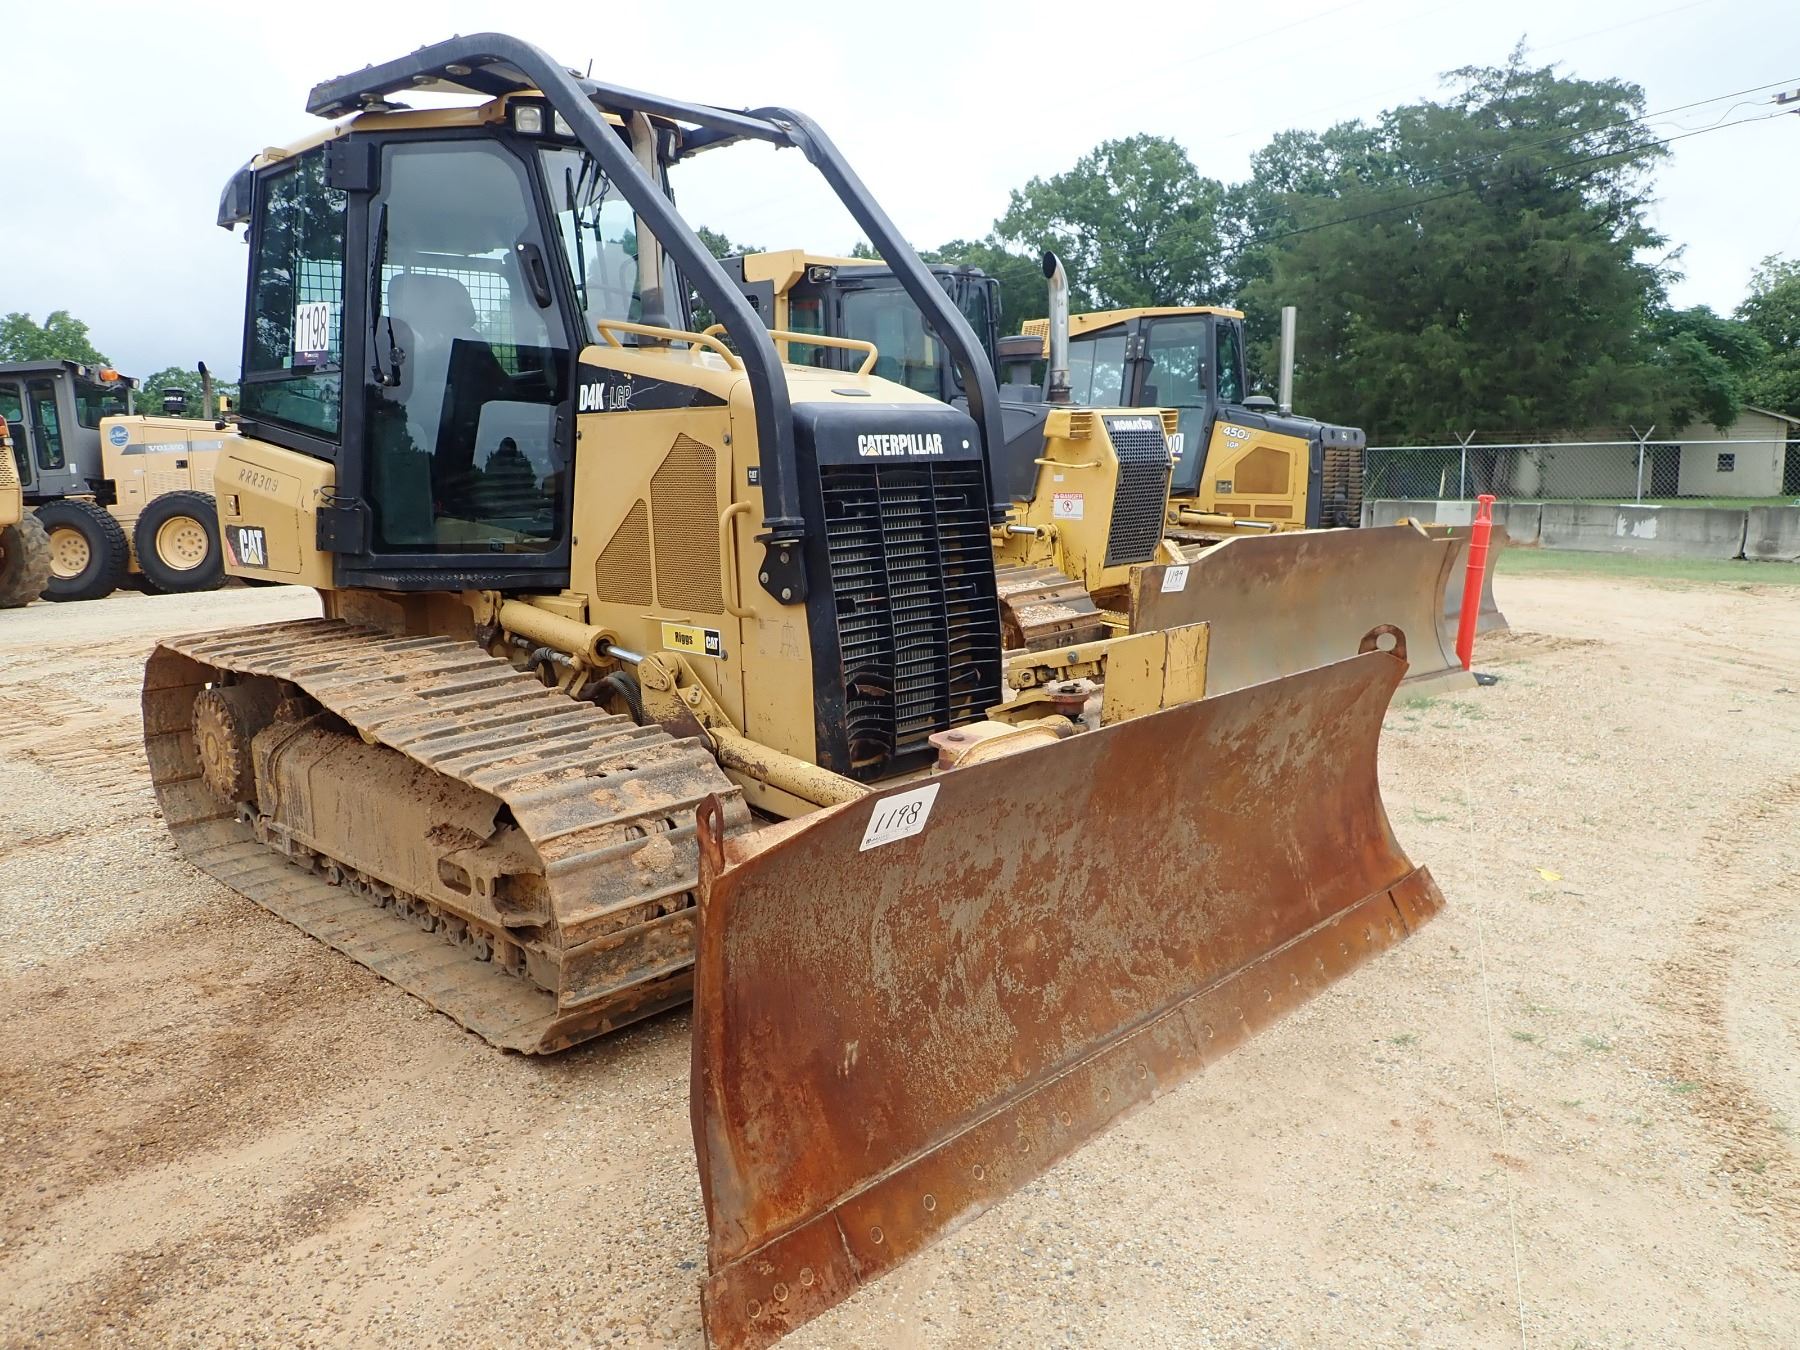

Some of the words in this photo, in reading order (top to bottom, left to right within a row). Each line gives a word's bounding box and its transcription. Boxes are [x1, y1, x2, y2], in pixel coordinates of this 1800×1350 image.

[299, 306, 327, 351] 1198
[579, 383, 605, 411] D4K
[610, 385, 631, 409] LGP
[1113, 417, 1153, 431] KOMATSU
[1223, 426, 1251, 440] 450J
[148, 443, 185, 452] VOLVO
[858, 433, 944, 456] CATERPILLAR
[239, 468, 279, 492] RRR309
[239, 529, 264, 565] CAT
[675, 631, 693, 646] Riggs
[706, 635, 719, 650] CAT
[874, 801, 922, 833] 1198
